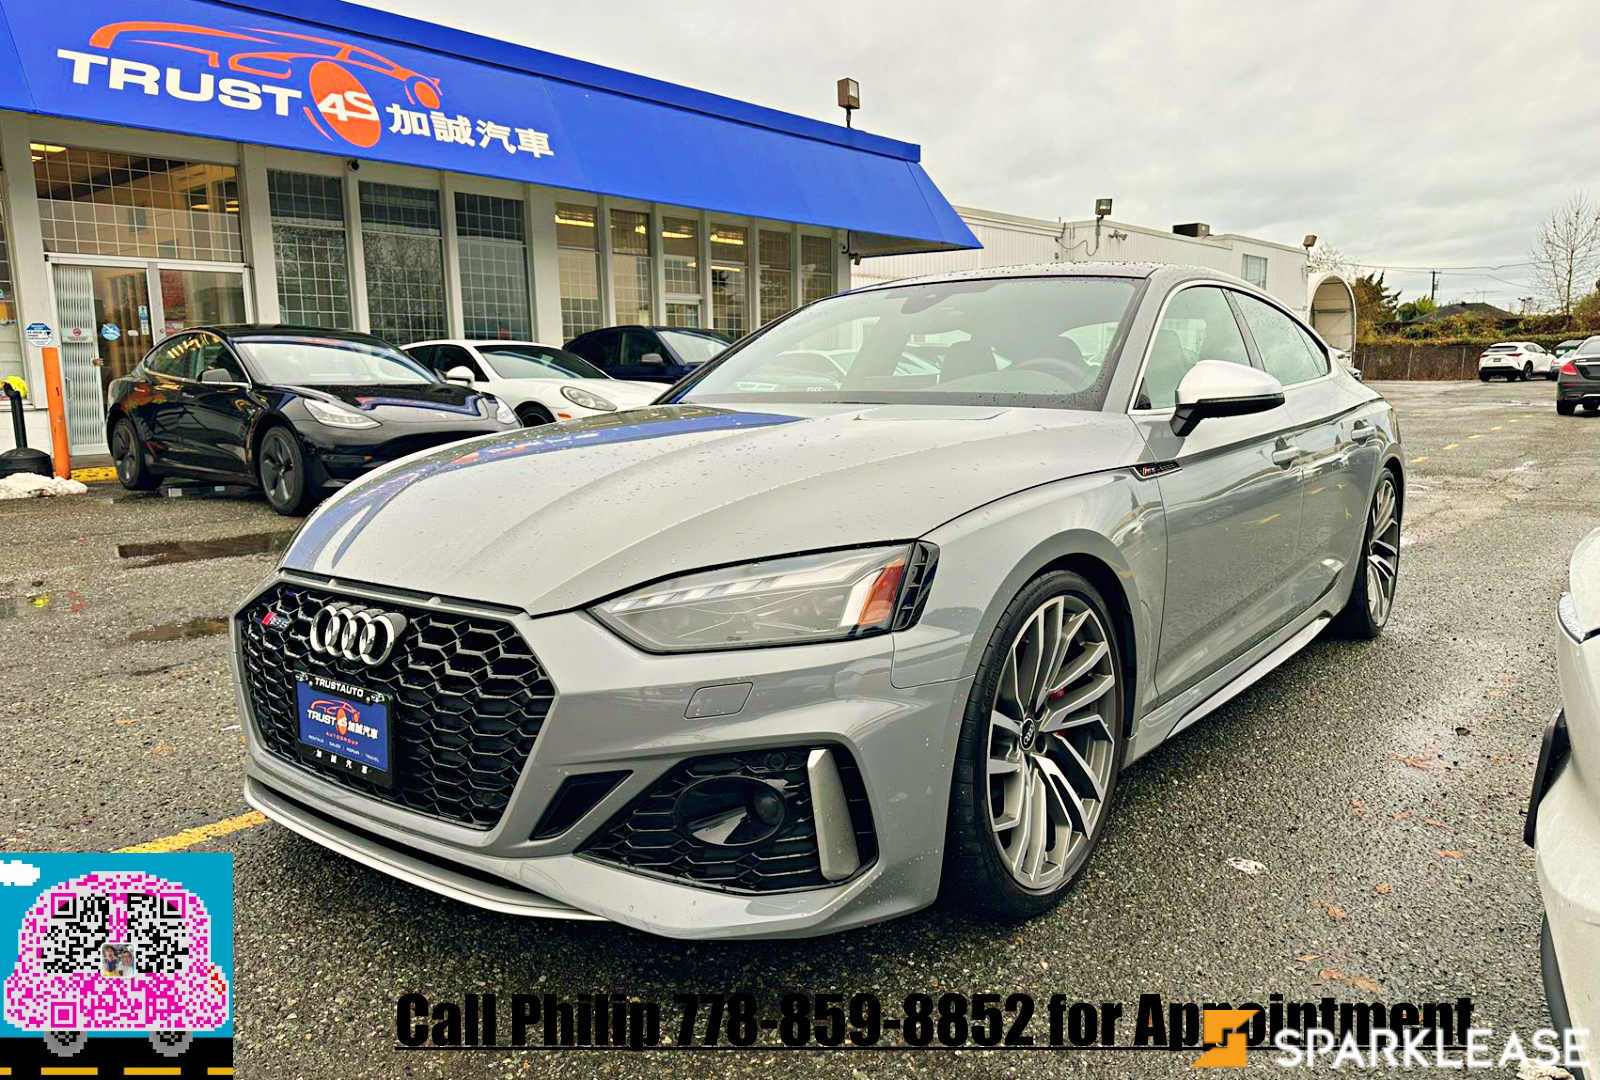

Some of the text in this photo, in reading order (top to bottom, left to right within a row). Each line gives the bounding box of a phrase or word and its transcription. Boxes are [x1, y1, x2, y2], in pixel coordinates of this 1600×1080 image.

[57, 48, 554, 158] TRUST 4S 加誠汽車
[314, 677, 363, 698] TRUSTAUTO
[307, 709, 337, 727] TRUST
